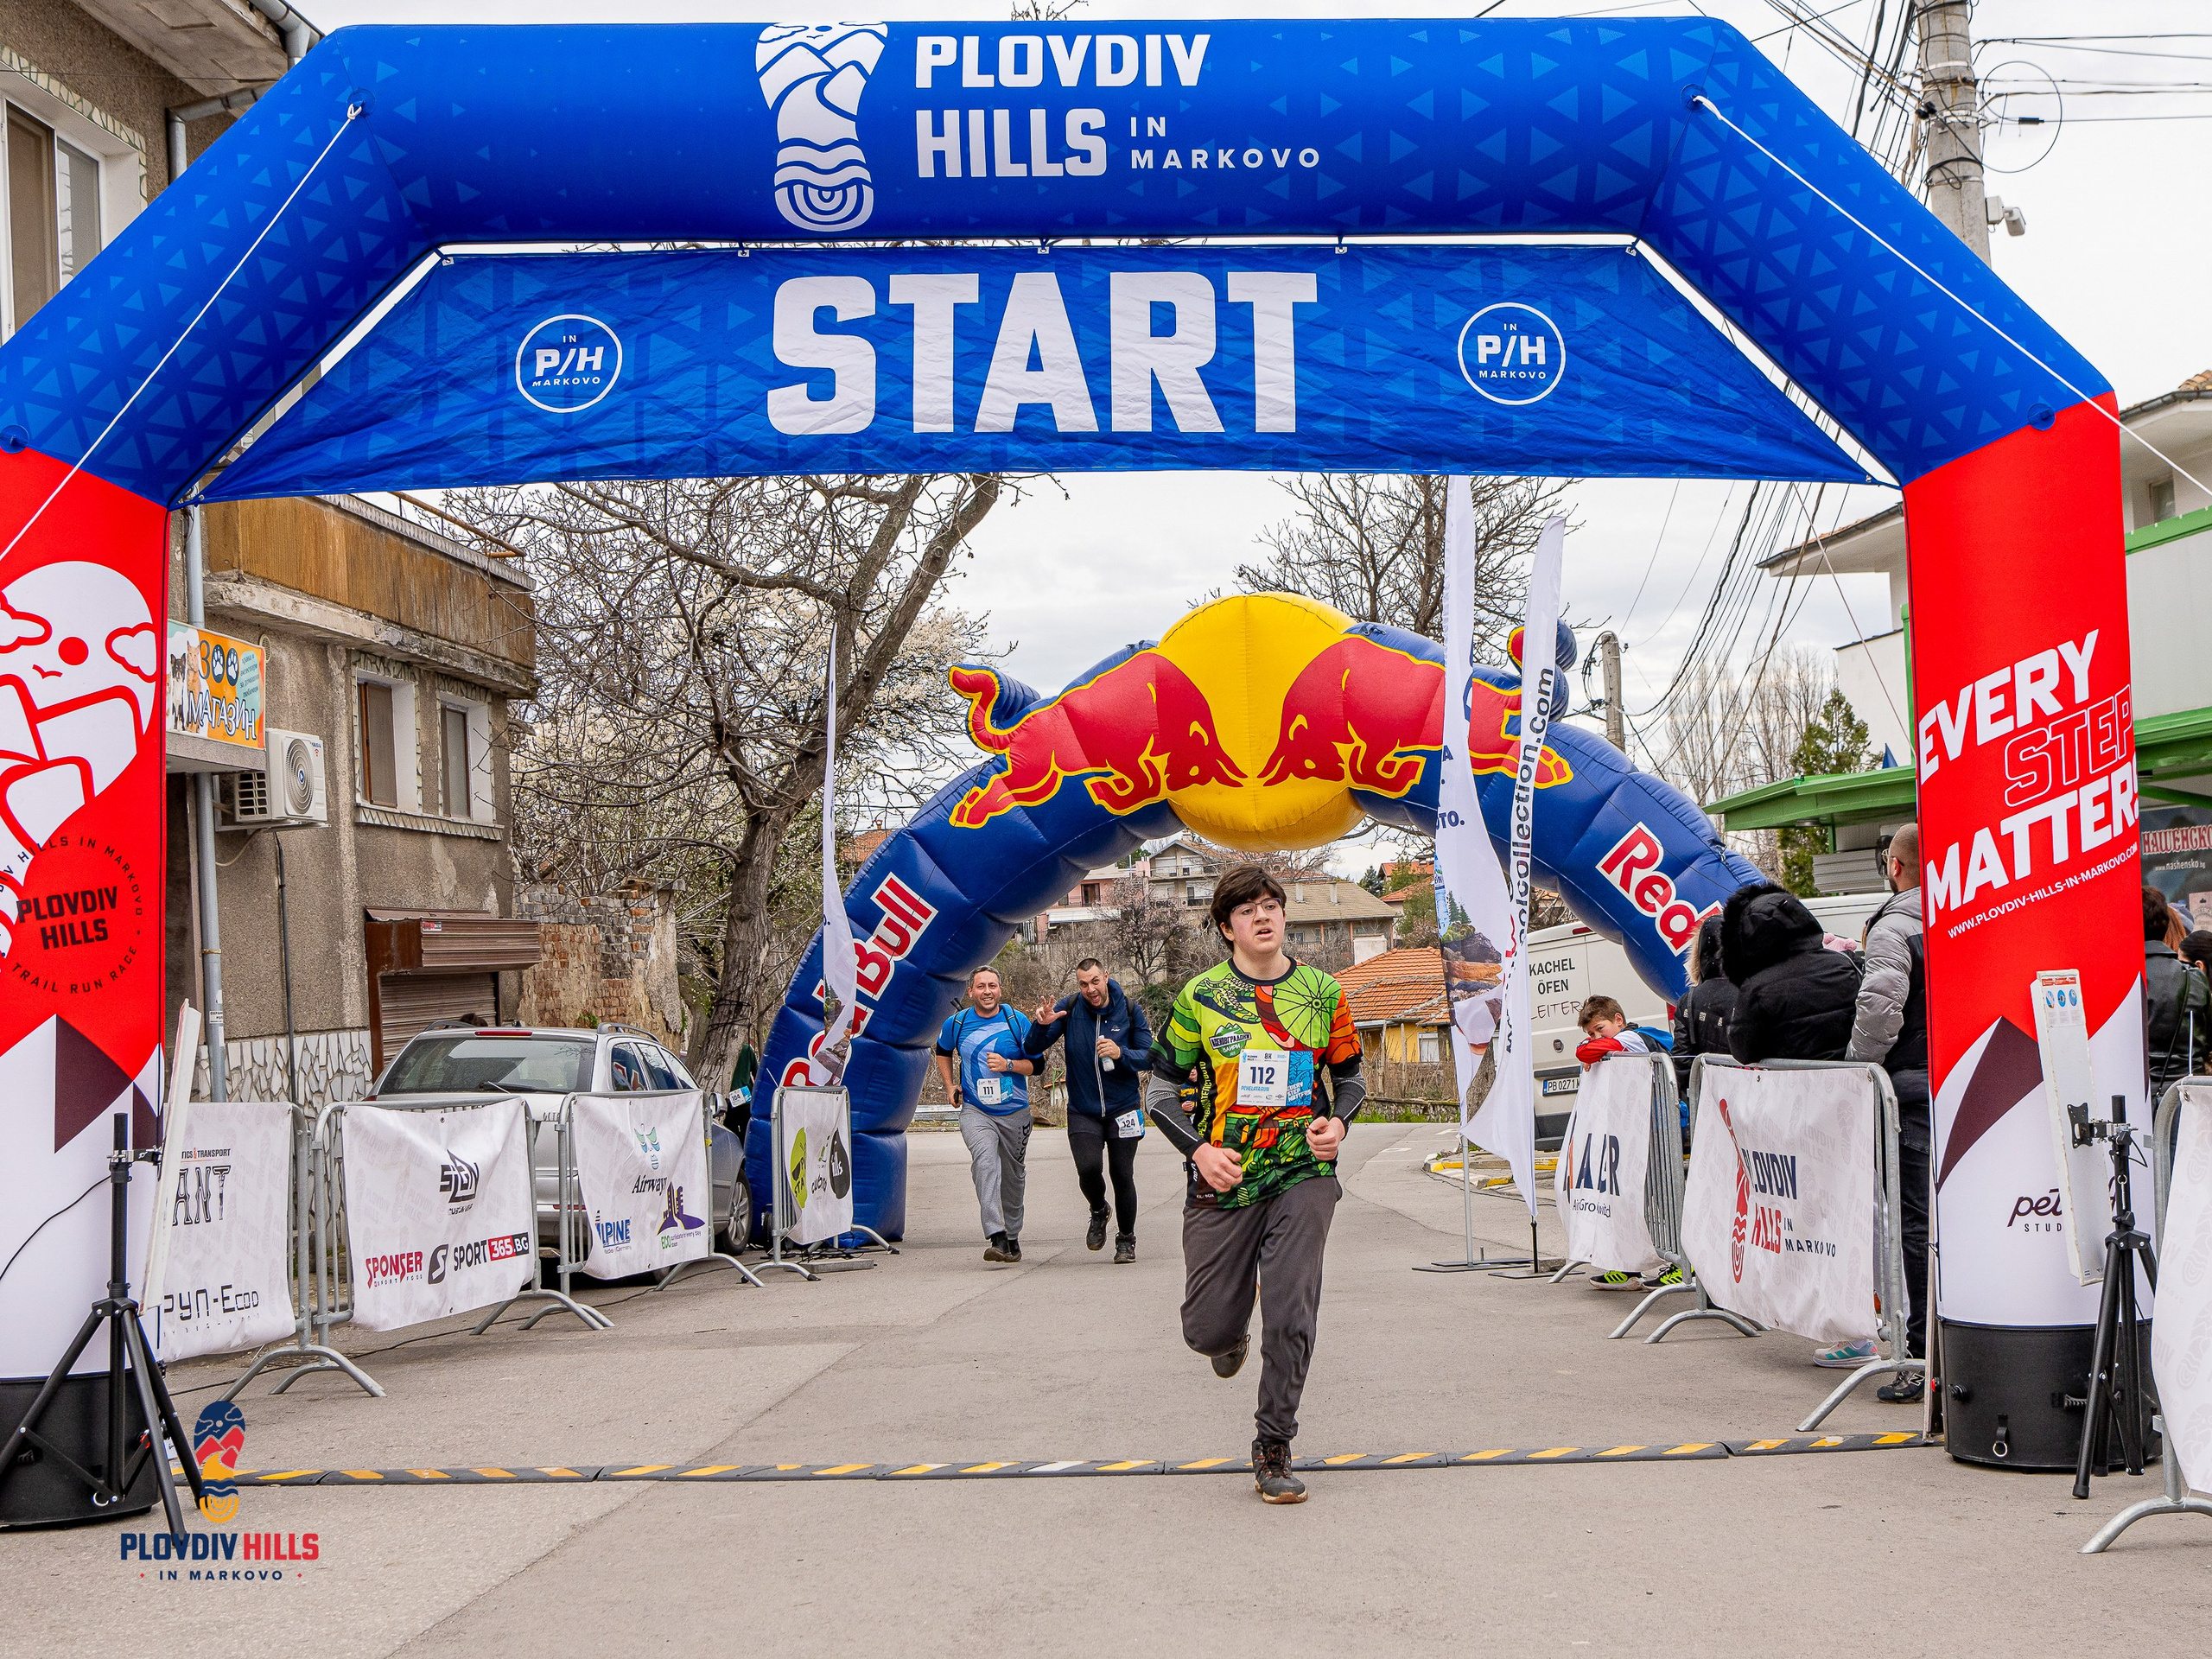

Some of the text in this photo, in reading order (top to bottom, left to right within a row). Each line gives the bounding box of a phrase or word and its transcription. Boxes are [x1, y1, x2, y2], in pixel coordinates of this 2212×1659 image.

[915, 35, 1211, 88] PLOVDIV
[1130, 117, 1166, 137] IN
[915, 108, 1107, 178] HILLS
[1130, 148, 1320, 170] MARKOVO
[535, 346, 604, 377] P/H
[767, 271, 1318, 435] START
[1477, 334, 1546, 367] P/H
[532, 377, 601, 387] MARKOVO
[1478, 370, 1546, 379] MARKOVO
[188, 690, 257, 741] МАГАЗИН
[1919, 629, 2100, 785] EVERY
[2004, 683, 2135, 807] STEP
[79, 836, 97, 849] IN
[1600, 826, 1724, 951] Red
[1947, 842, 2139, 939] WWW.PLOVDIV-HILLS-IN-MARKOVO.COM
[16, 886, 118, 924] PLOVDIV
[40, 918, 109, 950] HILLS
[11, 946, 137, 994] TRAIL RUN RACE
[1529, 957, 1576, 977] KACHEL
[1537, 978, 1570, 995] ÖFEN
[1250, 1066, 1275, 1084] 112
[1548, 1081, 1558, 1091] PB
[1558, 1079, 1575, 1091] 0271
[731, 1093, 741, 1102] 104
[982, 1086, 994, 1095] 111
[197, 1148, 231, 1158] TRANSPORT
[1783, 1217, 1794, 1232] IN
[1784, 1237, 1837, 1259] MARKOVO
[365, 1250, 423, 1289] SPONSER
